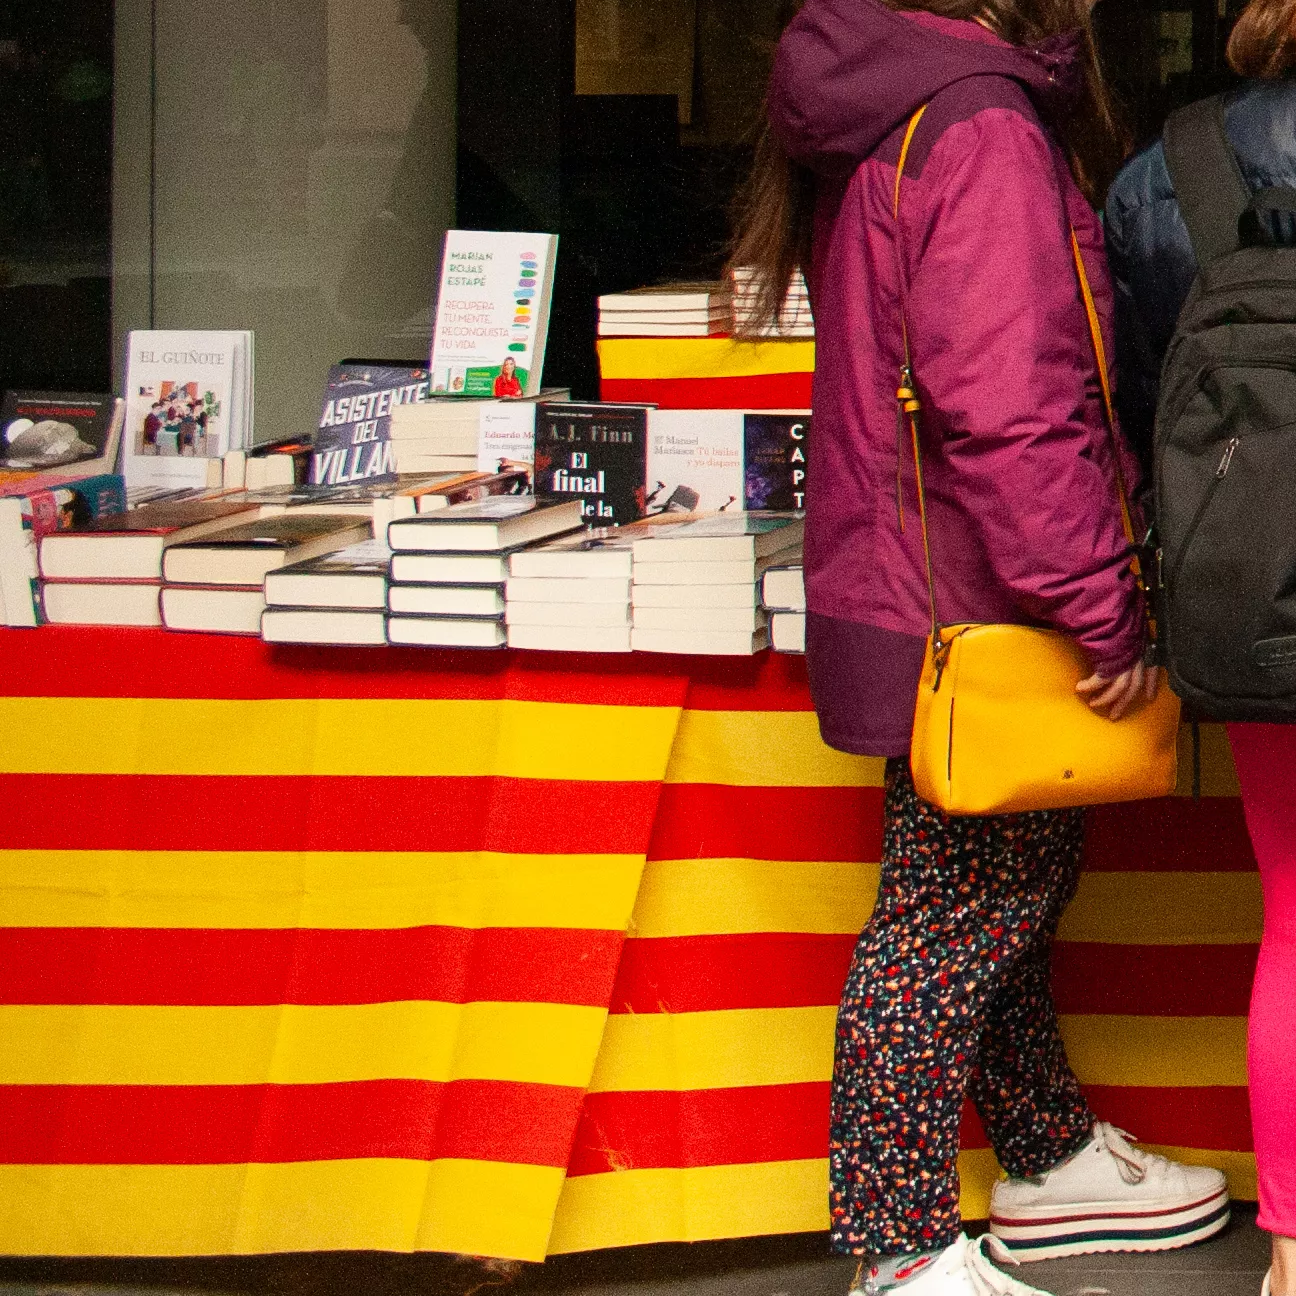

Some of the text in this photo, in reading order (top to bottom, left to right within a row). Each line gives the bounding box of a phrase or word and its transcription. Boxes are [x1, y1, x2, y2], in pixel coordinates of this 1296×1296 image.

[449, 264, 483, 274] ROJAS
[139, 349, 225, 365] EL GUIÑOTE
[352, 419, 380, 444] DEL
[590, 424, 633, 442] Finn
[666, 436, 699, 445] Manuel
[571, 452, 588, 469] El
[552, 469, 606, 494] final
[597, 500, 614, 517] la
